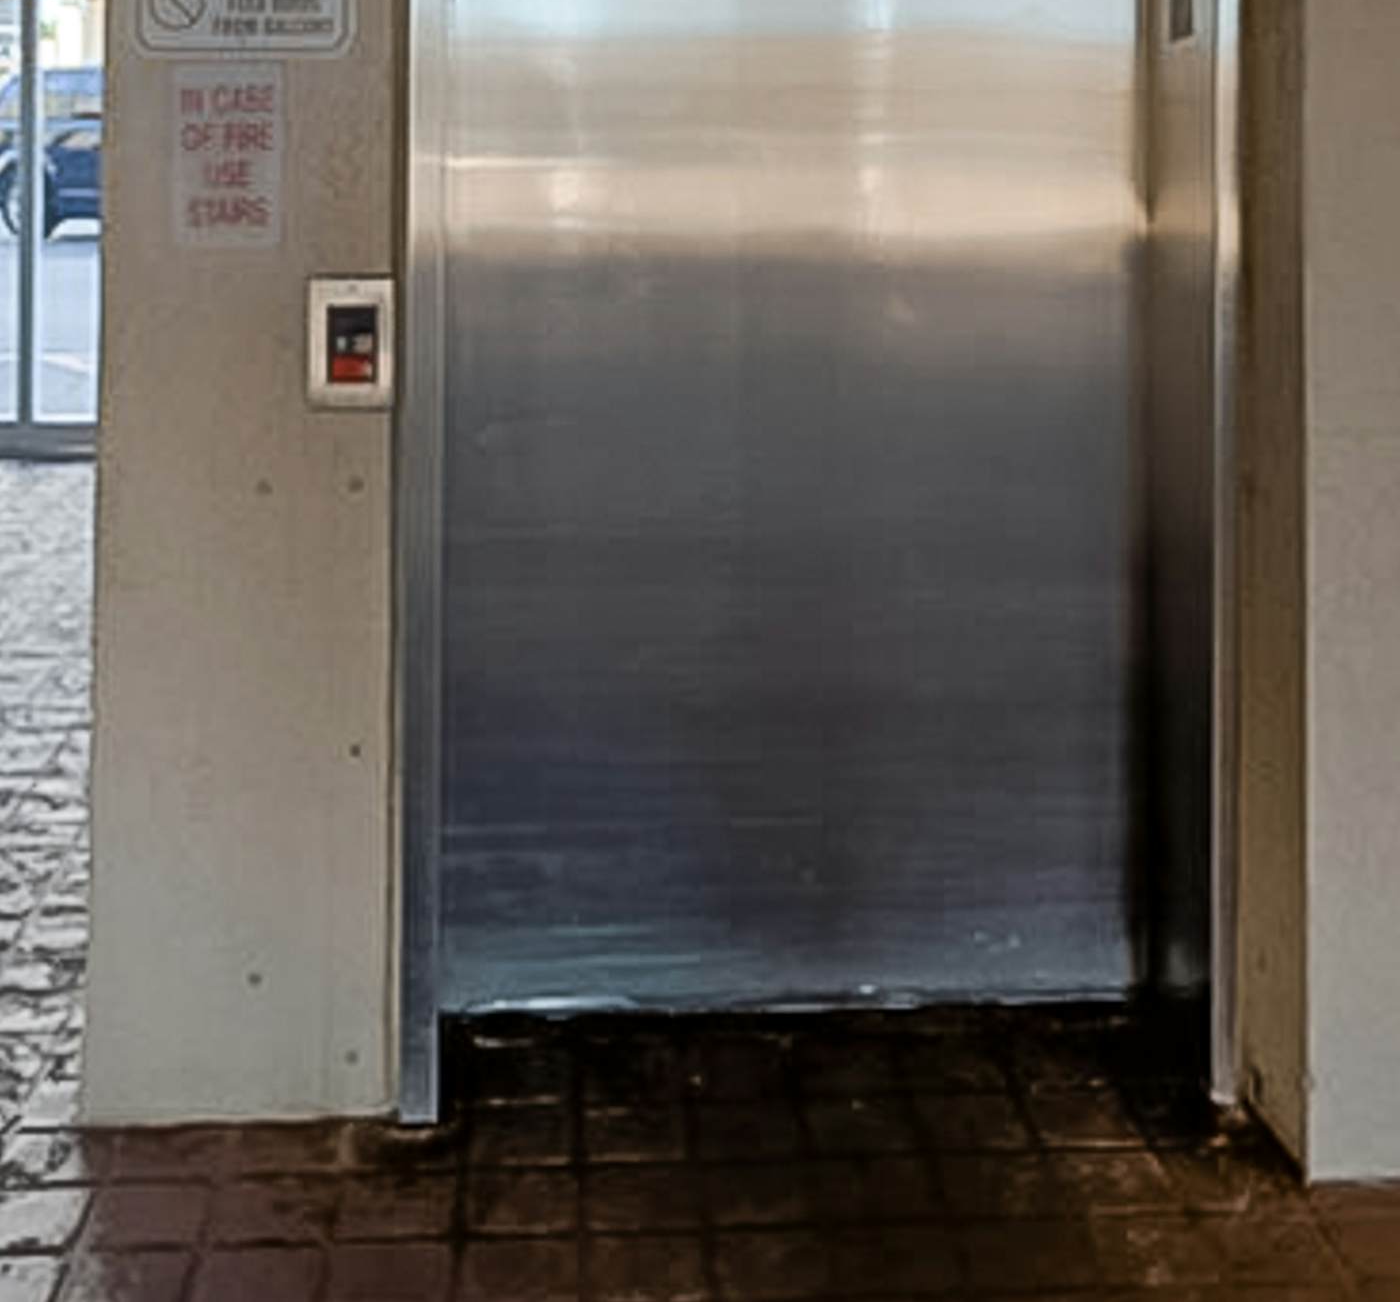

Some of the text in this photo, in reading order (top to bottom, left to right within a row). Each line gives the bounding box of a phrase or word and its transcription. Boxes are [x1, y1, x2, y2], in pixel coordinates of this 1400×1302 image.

[180, 85, 273, 113] IN CASE
[181, 121, 273, 151] OF FIRE
[204, 160, 252, 187] USE
[187, 196, 271, 227] STAIRS
